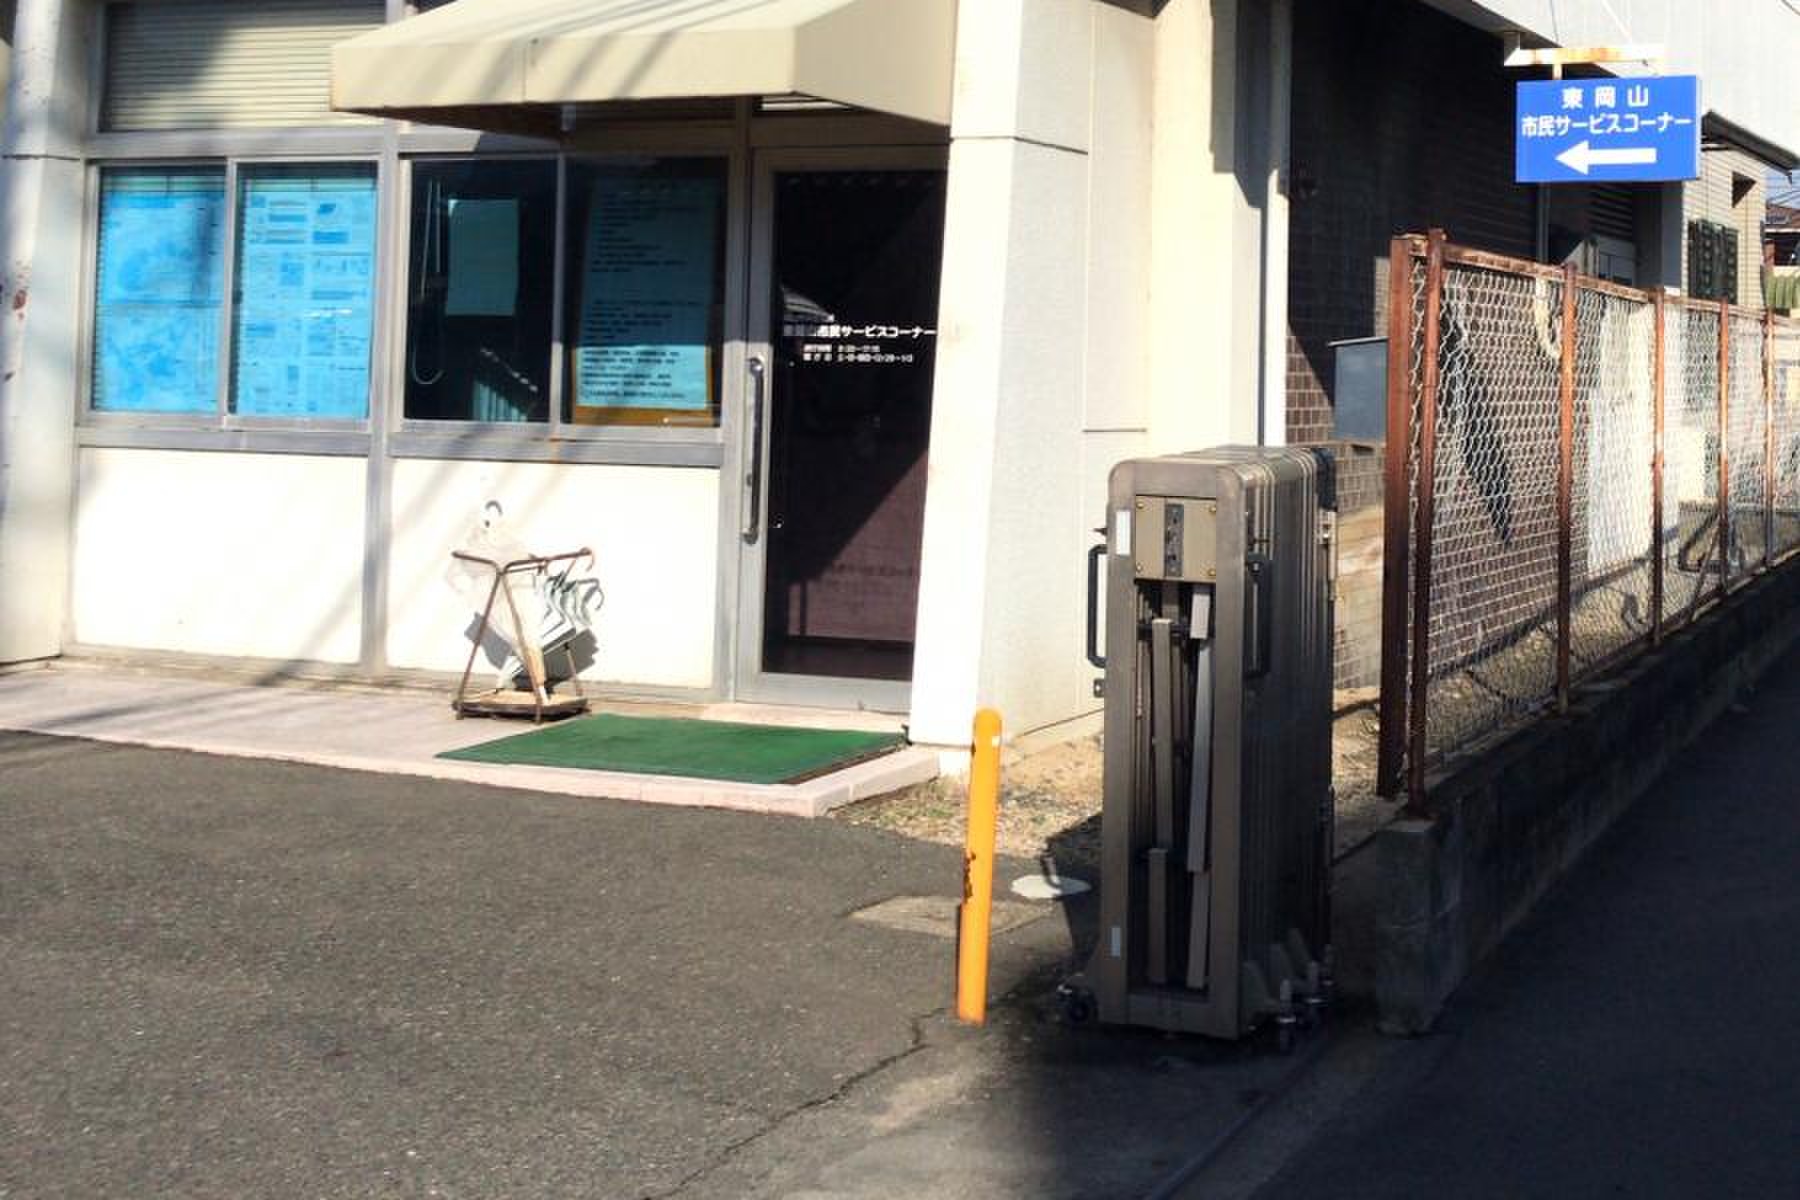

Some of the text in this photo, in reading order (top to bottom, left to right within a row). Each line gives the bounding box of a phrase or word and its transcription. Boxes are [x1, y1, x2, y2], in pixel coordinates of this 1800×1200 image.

[1521, 112, 1692, 137] 市民サービスコーナー
